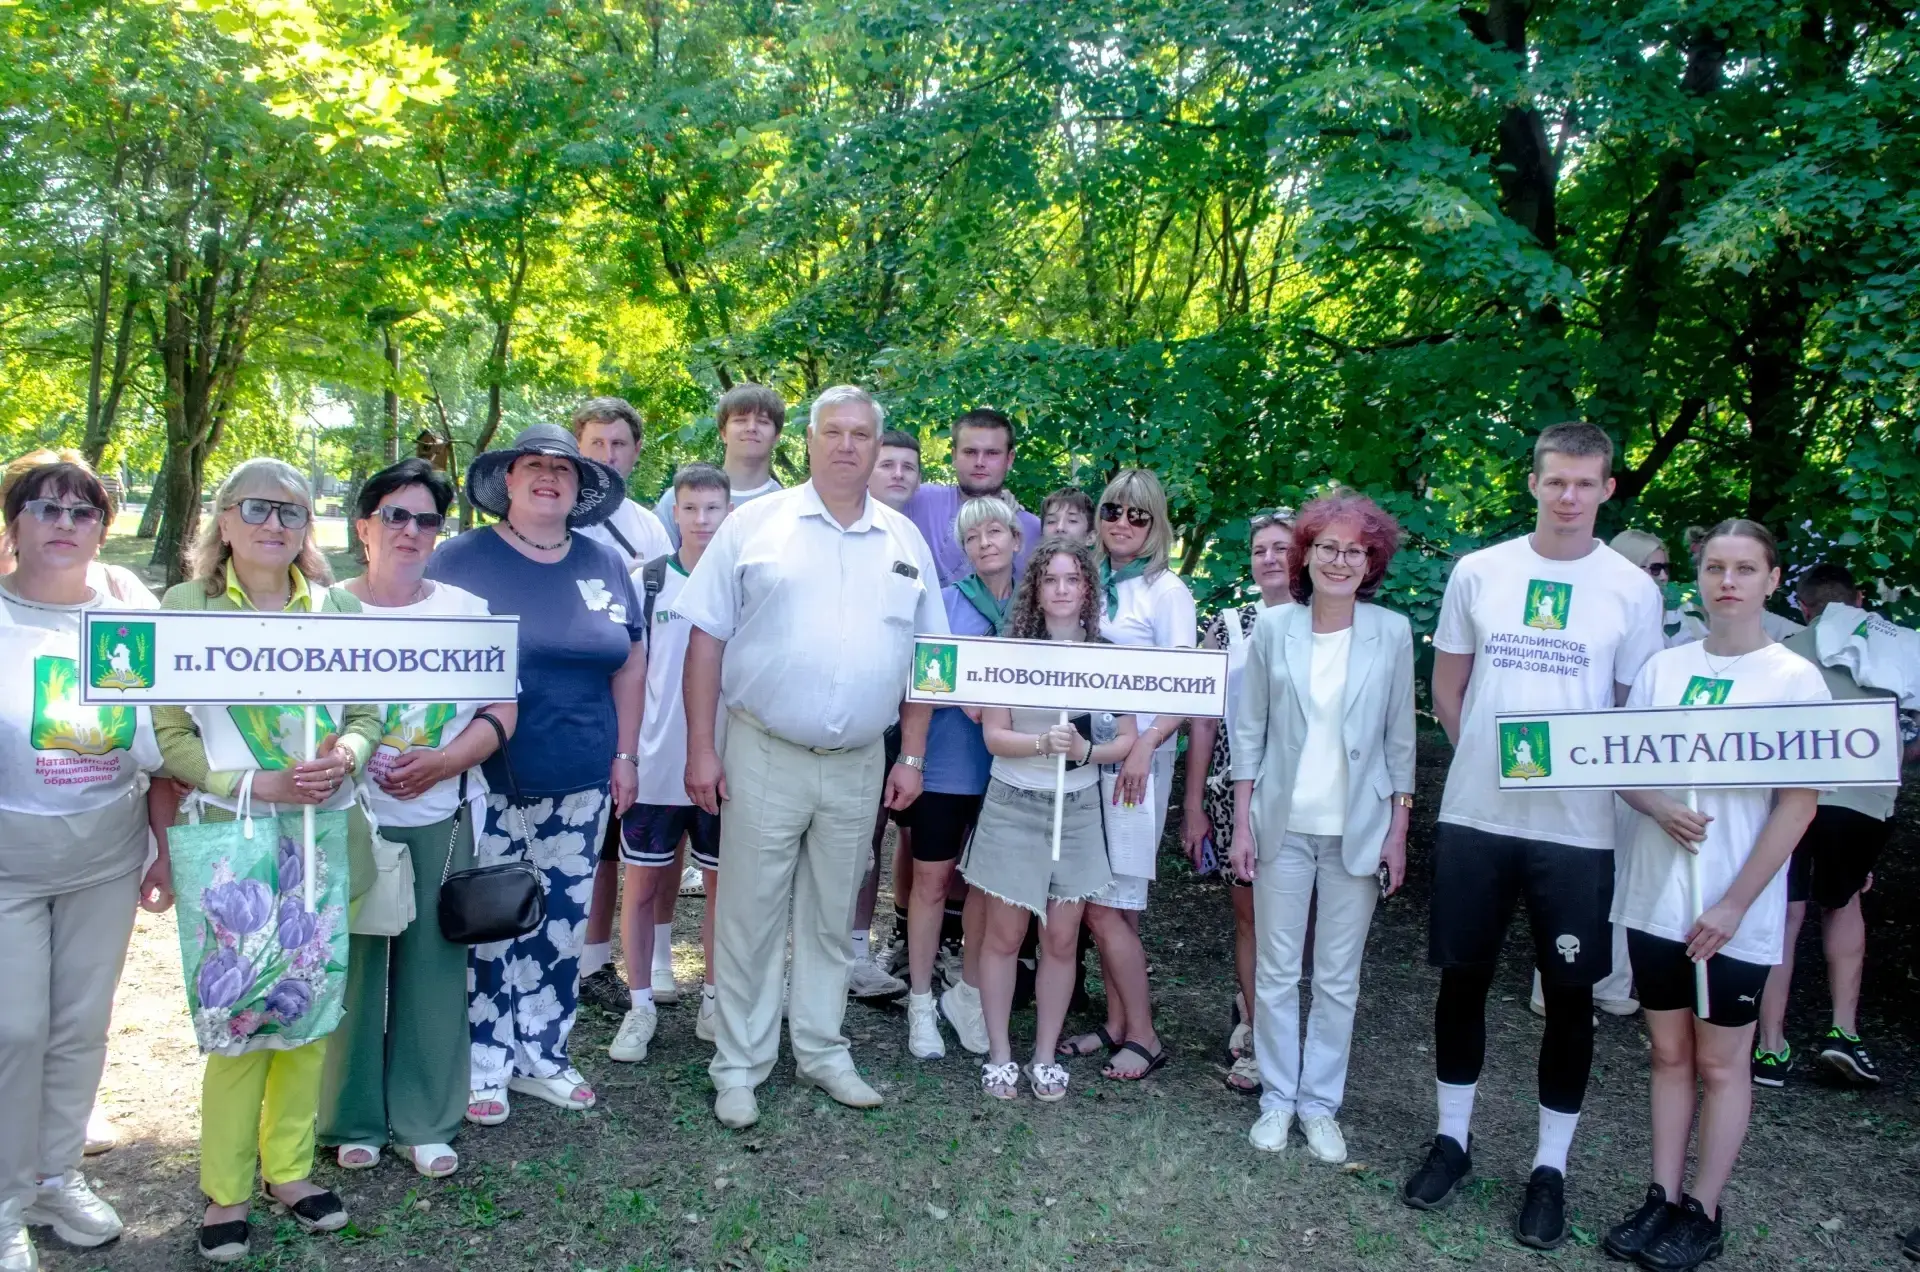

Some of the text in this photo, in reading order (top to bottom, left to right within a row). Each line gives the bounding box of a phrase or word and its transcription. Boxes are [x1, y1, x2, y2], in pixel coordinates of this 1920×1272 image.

[1491, 633, 1587, 653] НАТАЛЬИНСКОЕ
[174, 645, 506, 673] п.ГОЛОВАНОВСКИЙ
[1485, 645, 1591, 668] МУНИЦИПАЛЬНОЕ
[1492, 658, 1580, 677] ОБРАЗОВАНИЕ
[966, 667, 1216, 694] п.НОВОНИКОЛАЕВСКИЙ
[1570, 728, 1881, 766] с.НАТАЛЬИНО
[35, 765, 122, 777] муниципальное
[43, 774, 113, 786] образование
